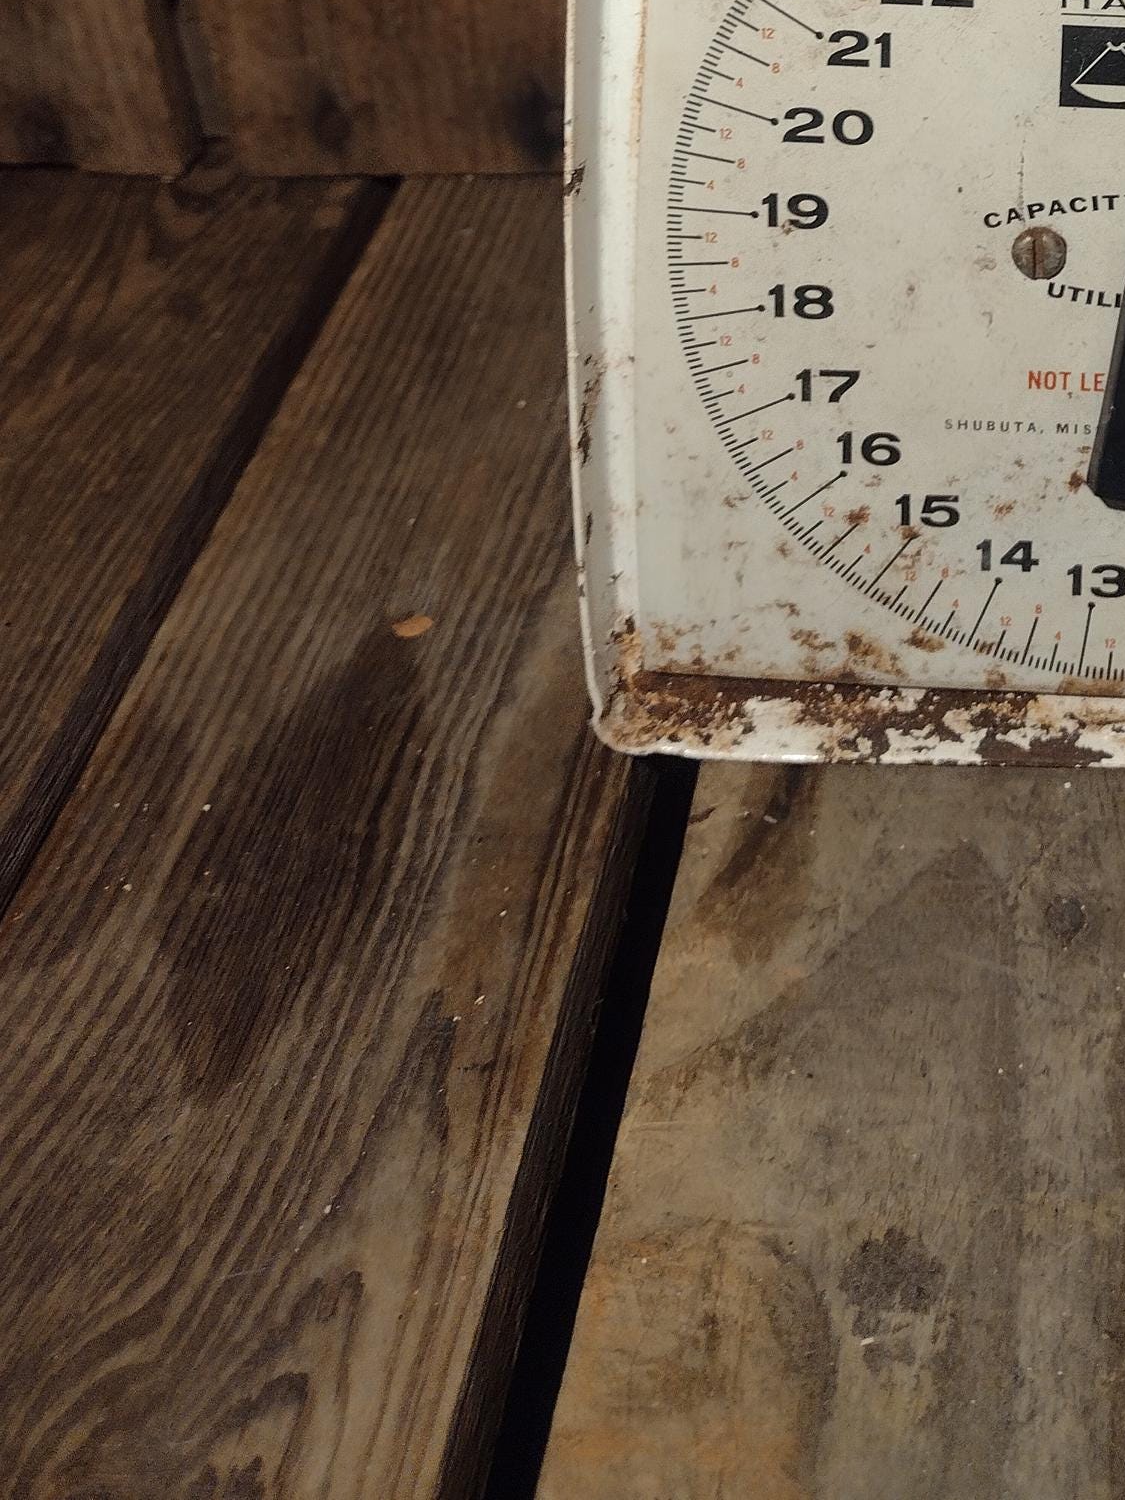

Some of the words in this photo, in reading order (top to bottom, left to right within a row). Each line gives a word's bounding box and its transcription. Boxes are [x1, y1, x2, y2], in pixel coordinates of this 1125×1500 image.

[762, 28, 776, 39] 12
[827, 30, 890, 68] 21
[772, 62, 780, 74] 8
[736, 77, 743, 88] 4
[783, 108, 873, 145] 20
[719, 129, 732, 140] 12
[736, 158, 745, 169] 8
[707, 180, 714, 190] 4
[762, 193, 828, 229] 19
[731, 257, 739, 268] 8
[709, 285, 717, 295] 4
[1048, 282, 1121, 308] UTILI
[769, 285, 833, 319] 18
[752, 354, 760, 364] 8
[796, 369, 860, 403] 17
[1028, 370, 1072, 391] NOT
[738, 384, 744, 394] 4
[944, 419, 1044, 435] SHUBUTA,
[762, 430, 773, 440] 12
[796, 440, 804, 450] 8
[837, 432, 900, 466] 16
[791, 471, 798, 481] 4
[896, 494, 959, 527] 15
[977, 540, 1039, 572] 14
[941, 566, 949, 579] 8
[952, 599, 959, 609] 4
[1035, 604, 1042, 614] 8
[1000, 616, 1012, 626] 12
[1054, 631, 1061, 640] 4
[1105, 638, 1116, 648] 12
